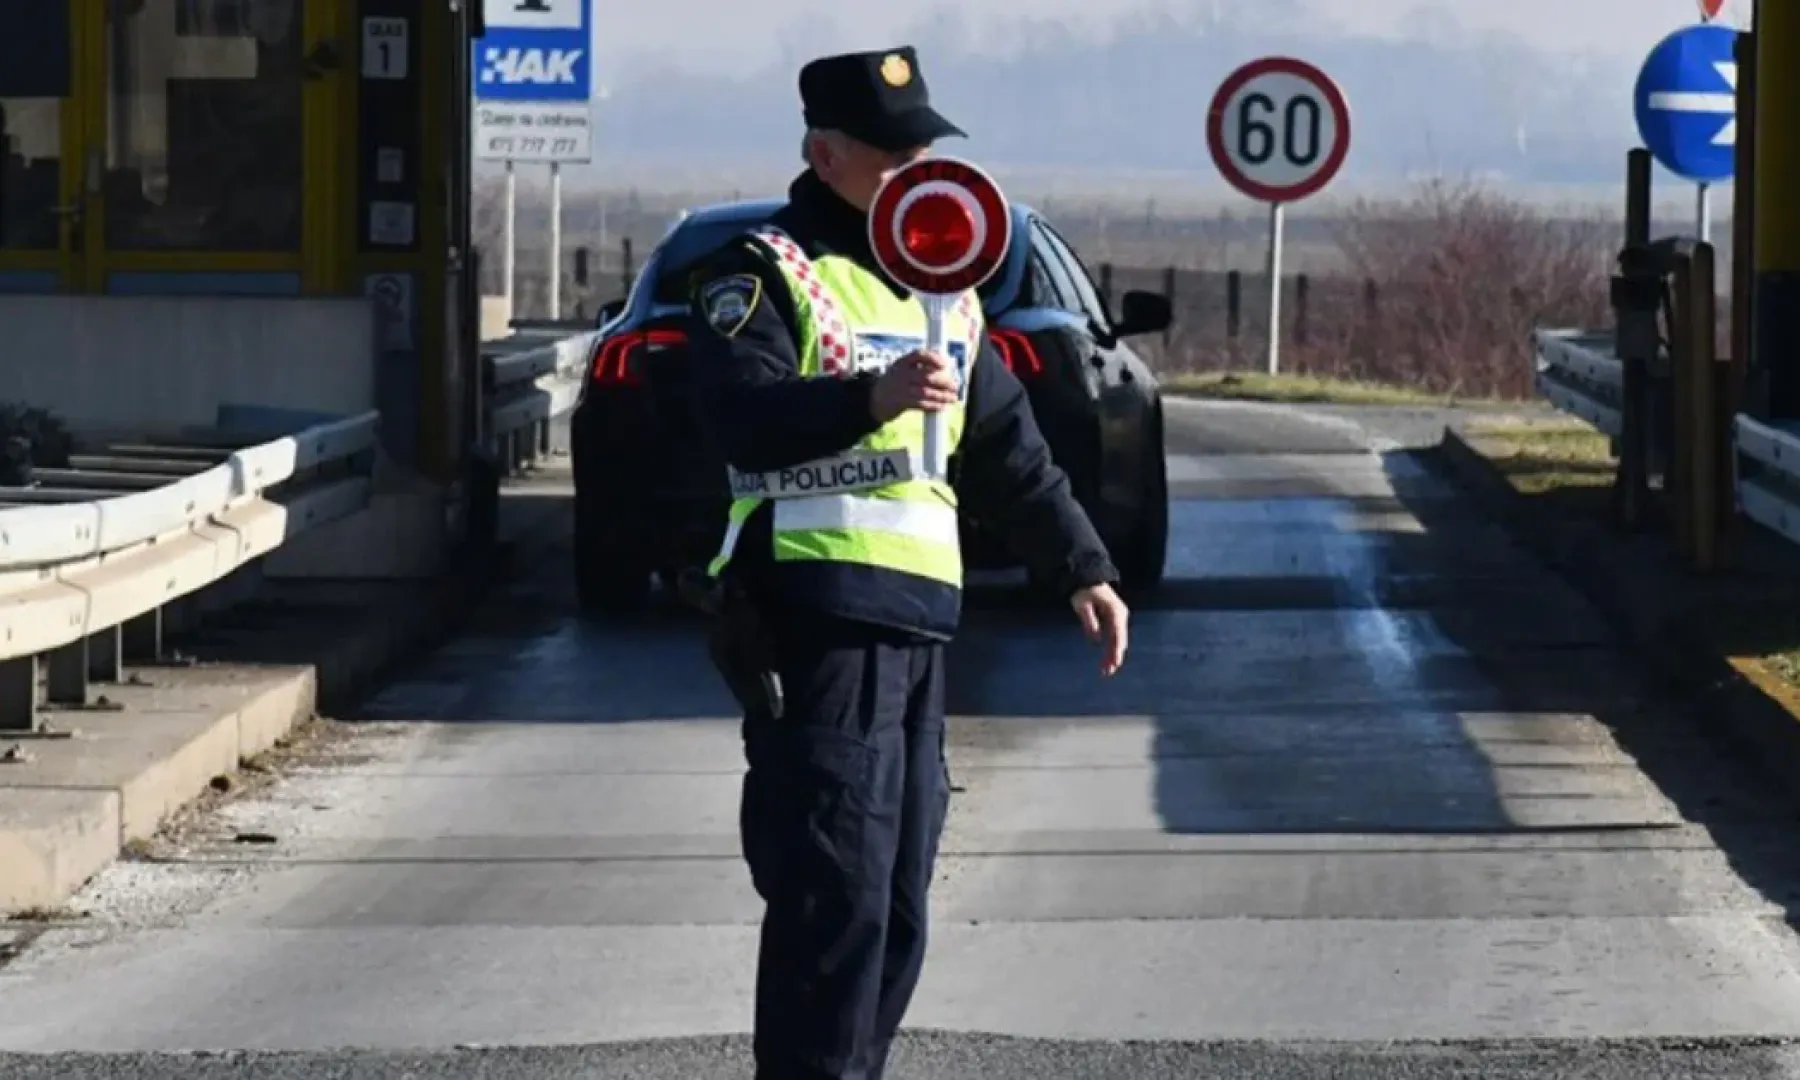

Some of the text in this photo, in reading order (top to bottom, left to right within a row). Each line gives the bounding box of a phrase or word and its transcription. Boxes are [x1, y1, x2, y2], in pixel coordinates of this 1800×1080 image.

[378, 41, 389, 72] 1
[480, 48, 583, 84] HAK
[1238, 92, 1321, 167] 60
[780, 456, 899, 492] POLICIJA
